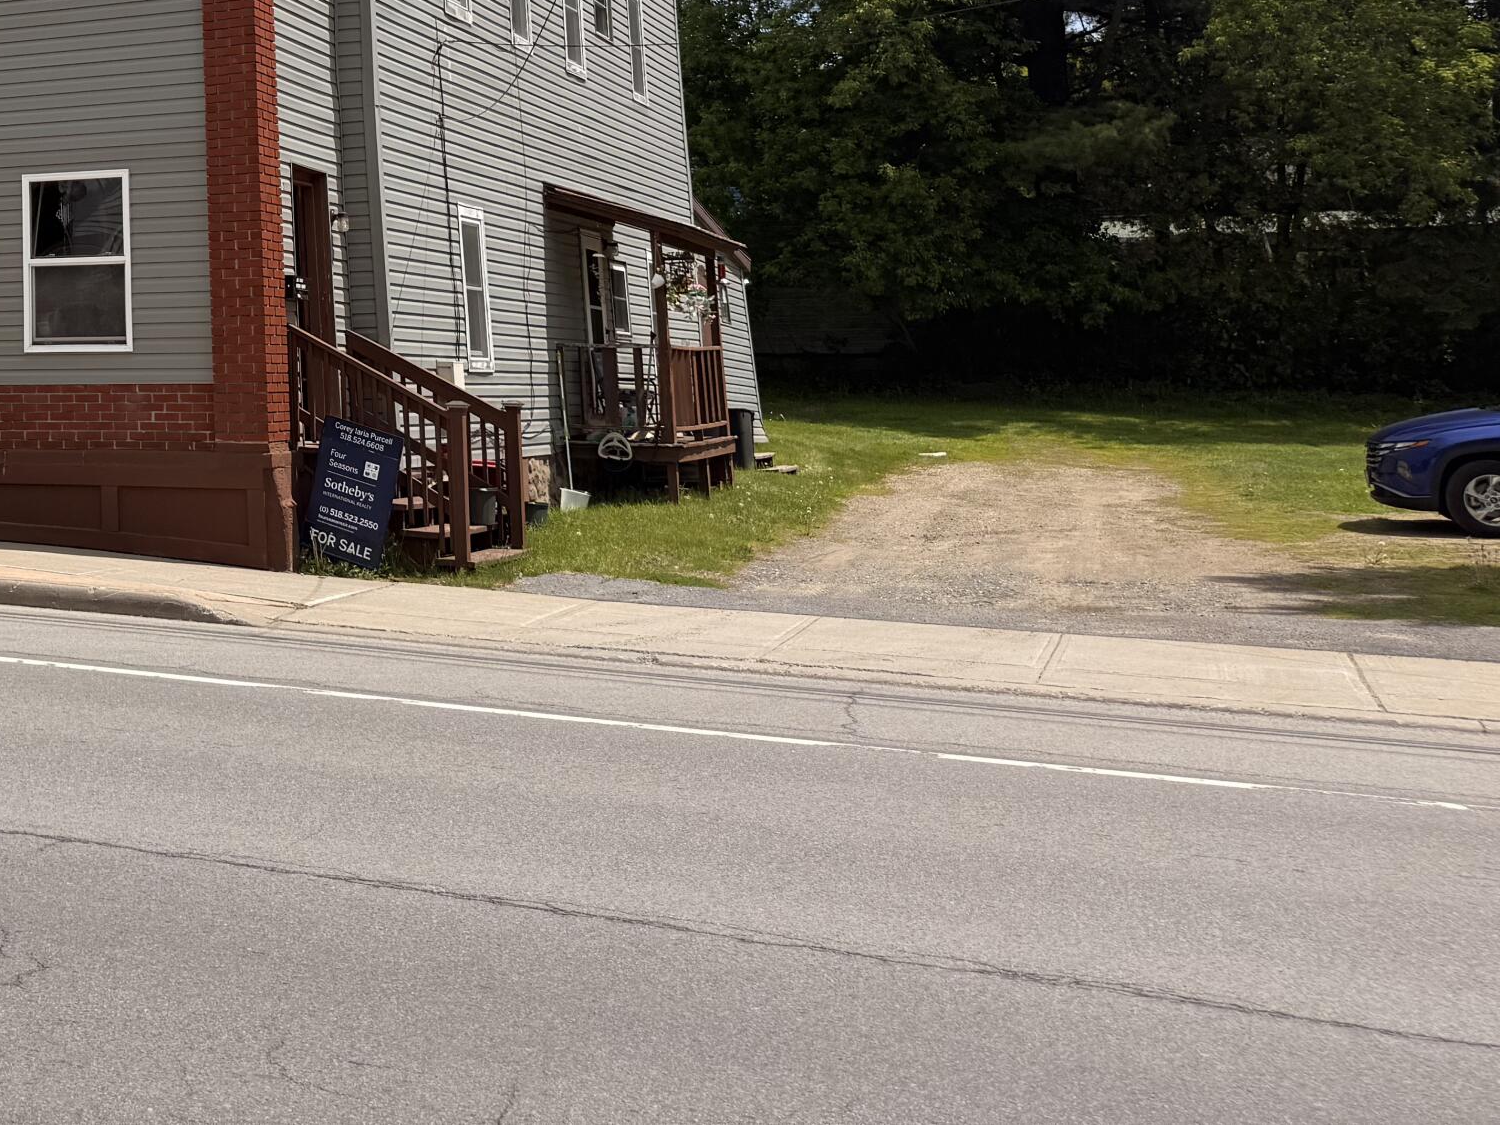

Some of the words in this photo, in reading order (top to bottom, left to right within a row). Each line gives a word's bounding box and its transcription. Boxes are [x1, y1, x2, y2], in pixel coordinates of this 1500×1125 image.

[335, 421, 354, 434] Corey
[370, 432, 393, 445] Purcell
[340, 432, 384, 452] 518.524.6608
[330, 448, 347, 459] Four
[329, 458, 358, 475] Seasons
[324, 477, 375, 502] Sotheby's
[330, 508, 379, 531] 518.523.2550
[310, 527, 336, 548] FOR
[338, 538, 373, 561] SALE
